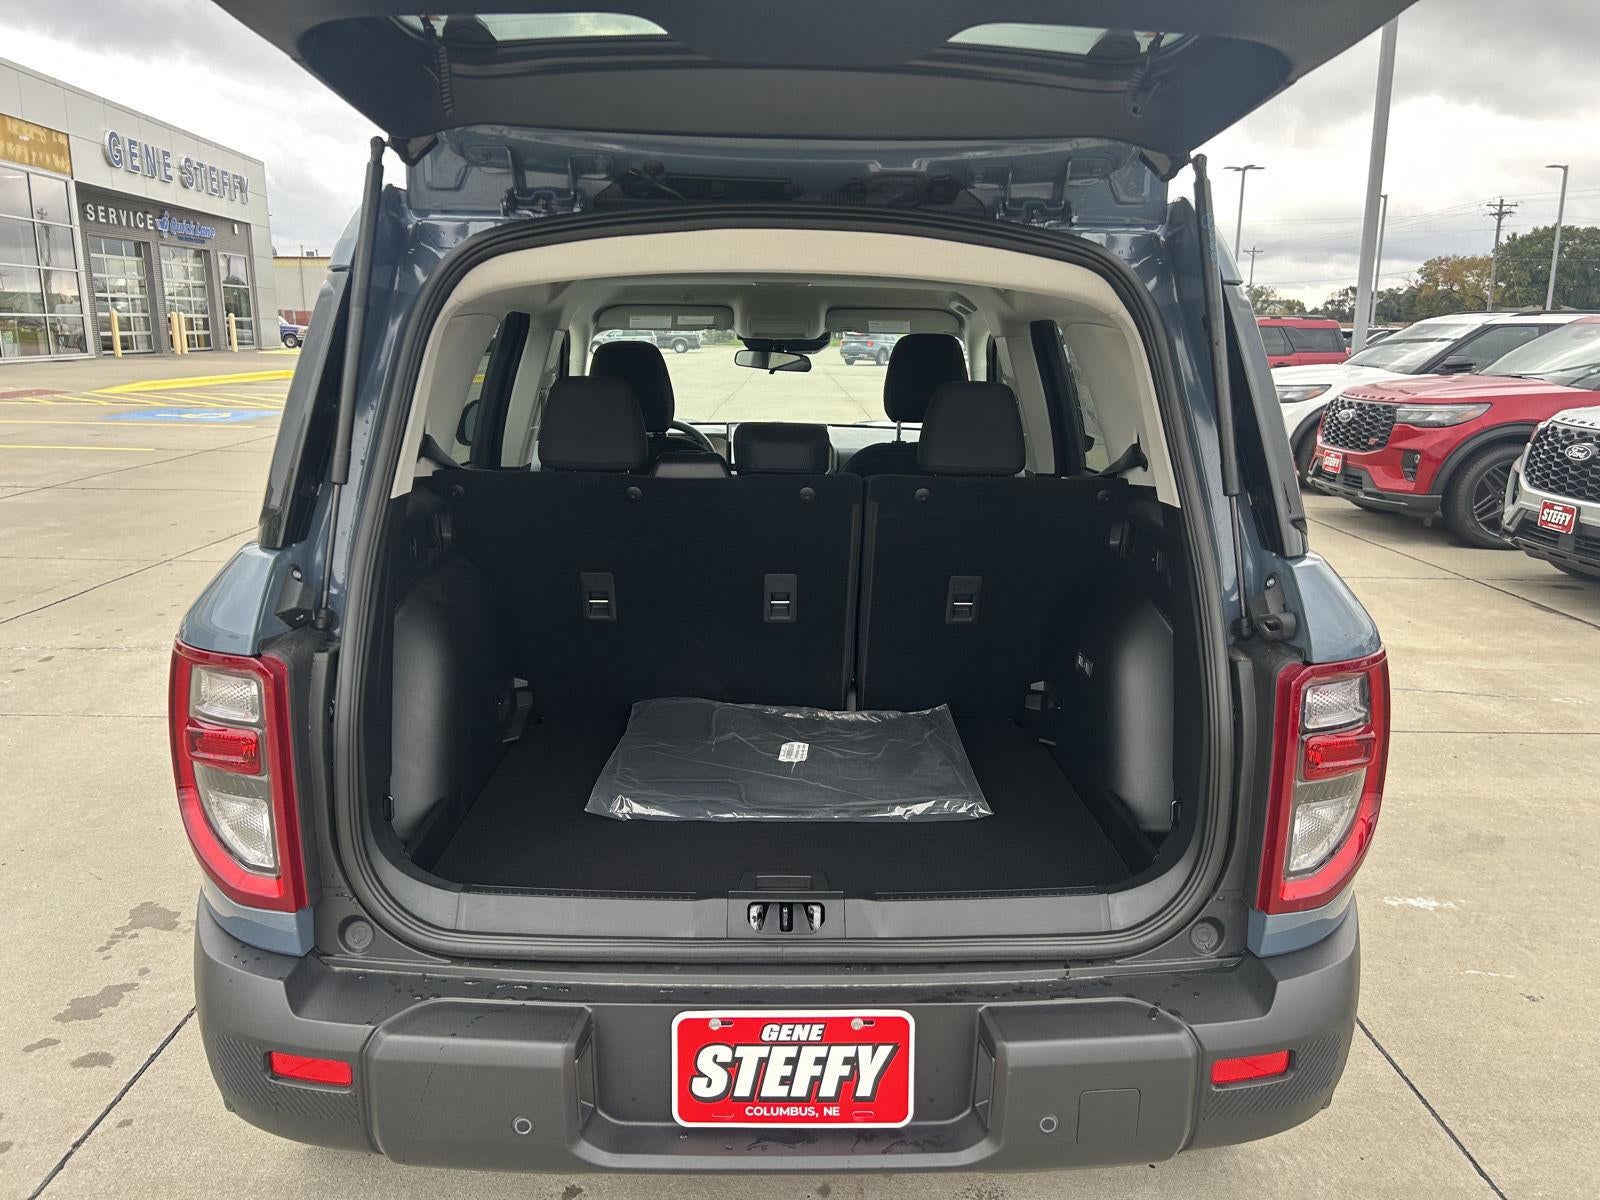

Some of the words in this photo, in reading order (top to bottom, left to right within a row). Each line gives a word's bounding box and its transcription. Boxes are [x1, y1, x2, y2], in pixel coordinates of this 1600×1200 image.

[104, 129, 173, 183] GENE
[180, 156, 249, 204] STEFFY
[86, 203, 154, 230] SERVICE
[170, 217, 195, 235] Quick
[195, 220, 216, 239] Lane
[1568, 446, 1589, 459] Ford
[1541, 508, 1572, 526] STEFFY
[760, 1023, 827, 1042] GENE
[690, 1043, 899, 1102] STEFFY
[745, 1106, 819, 1118] COLUMBUS,
[823, 1106, 840, 1117] NE
